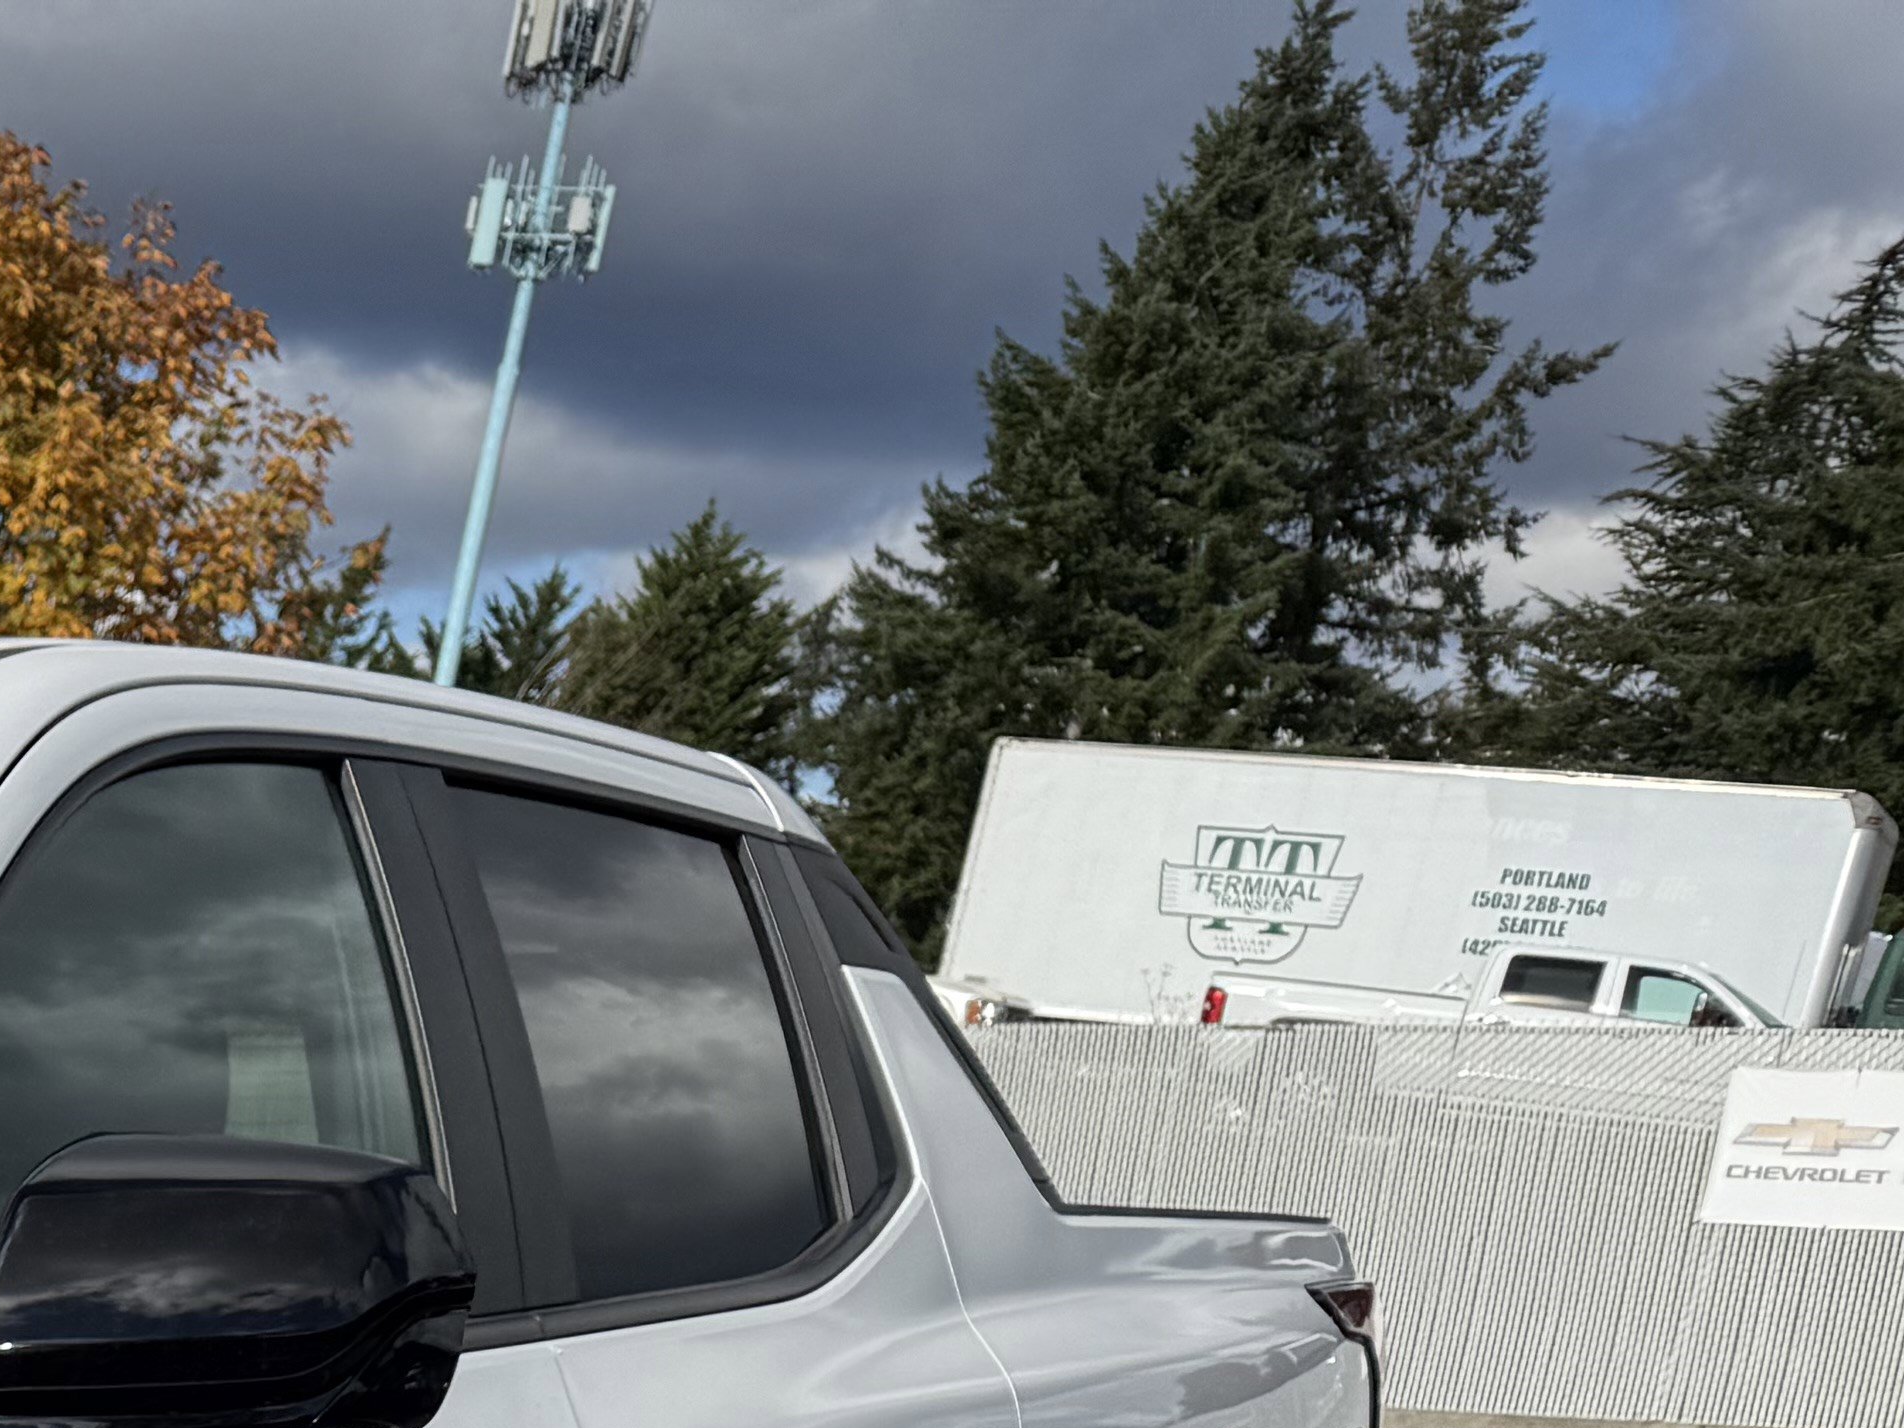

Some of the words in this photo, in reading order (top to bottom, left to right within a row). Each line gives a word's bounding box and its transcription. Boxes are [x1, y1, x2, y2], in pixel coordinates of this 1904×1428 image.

[1193, 872, 1322, 902] TERMINAL
[1500, 867, 1591, 890] PORTLAND
[1214, 890, 1293, 914] TRANSFER
[1471, 890, 1520, 910] (503)
[1523, 895, 1607, 917] 288-7164
[1498, 916, 1568, 938] SEATTLE
[1725, 1164, 1891, 1184] CHEVROLET
